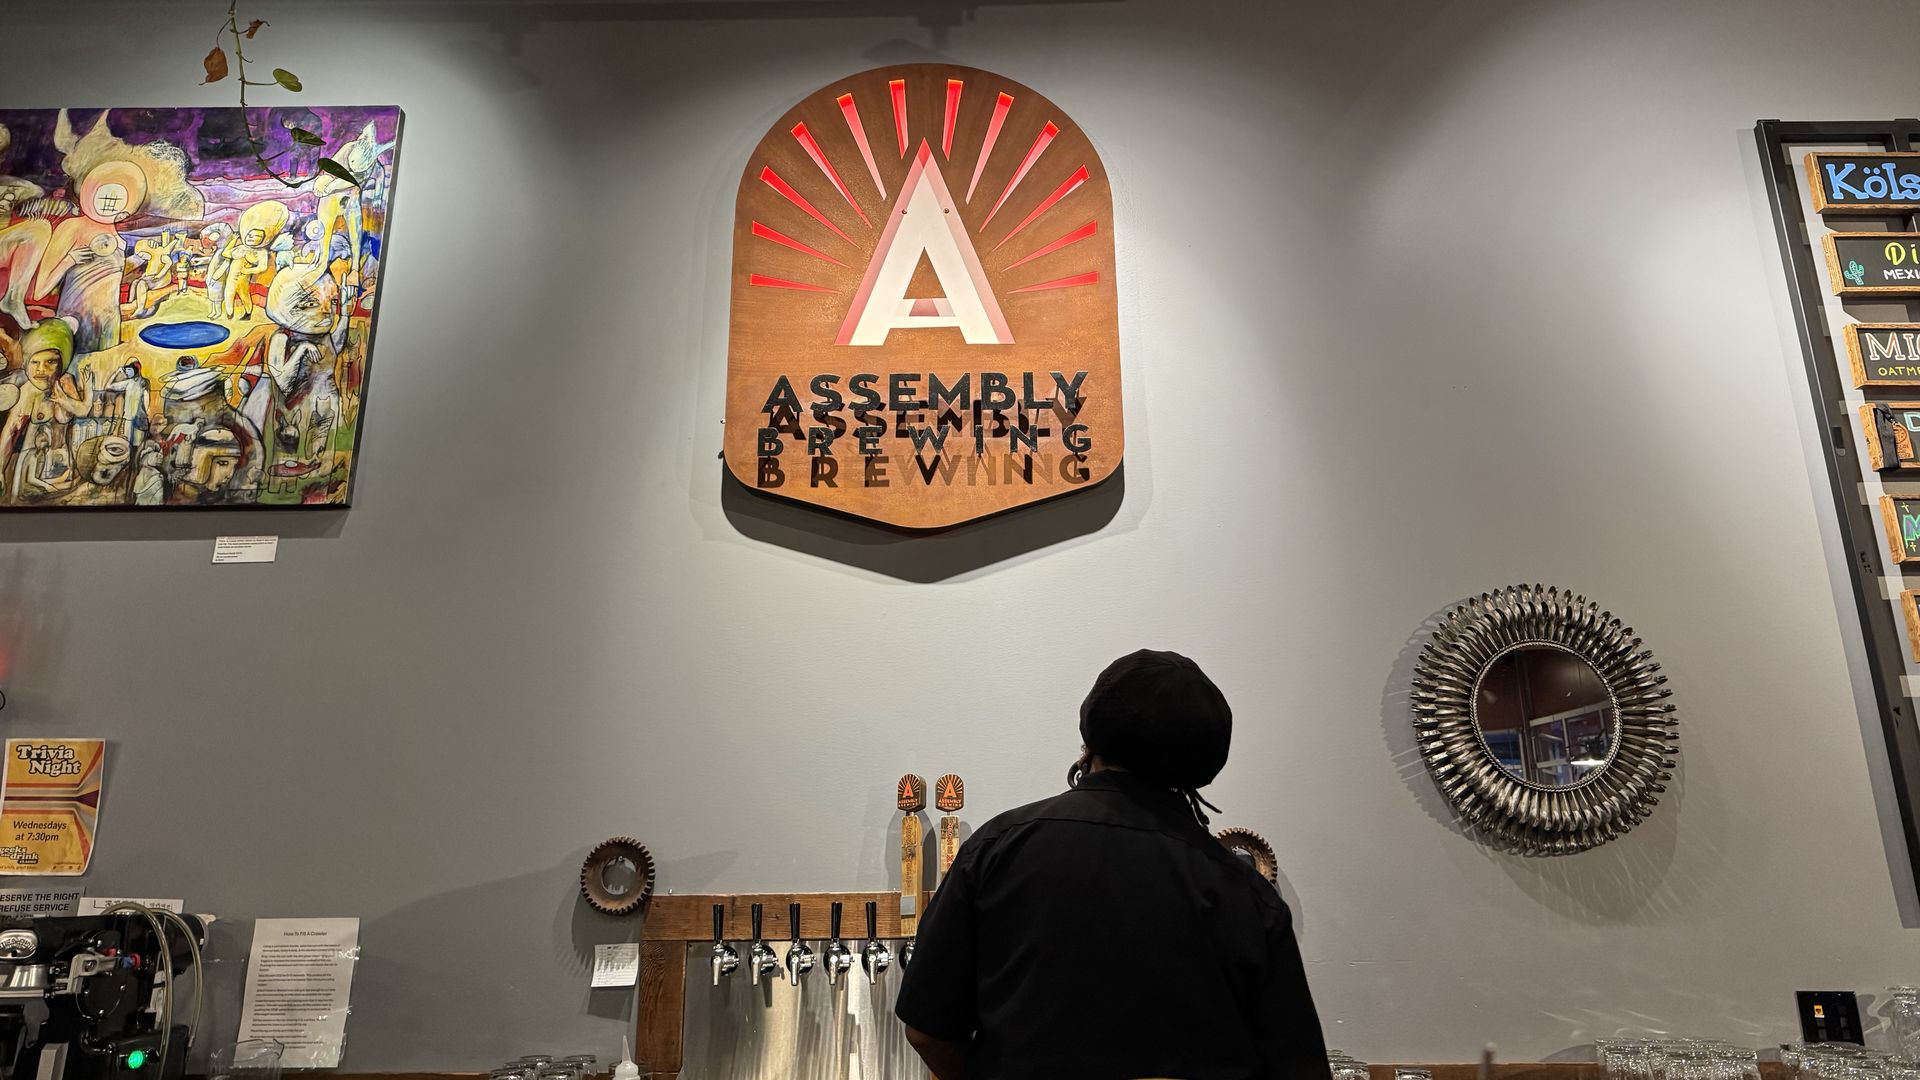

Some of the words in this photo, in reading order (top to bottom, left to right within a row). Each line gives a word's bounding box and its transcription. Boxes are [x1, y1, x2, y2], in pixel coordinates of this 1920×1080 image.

[1825, 163, 1920, 200] Köls
[834, 136, 1016, 346] A
[761, 371, 1089, 413] ASSEMBLY
[757, 423, 1092, 457] BREWING
[17, 745, 75, 760] Trivia
[29, 760, 81, 777] Night
[13, 820, 67, 831] Wednesdays
[15, 833, 24, 841] at
[27, 832, 60, 842] 7:30pm
[10, 852, 38, 860] drink
[35, 893, 52, 901] THE
[53, 892, 80, 901] RIGHT
[33, 903, 70, 912] SERVICE
